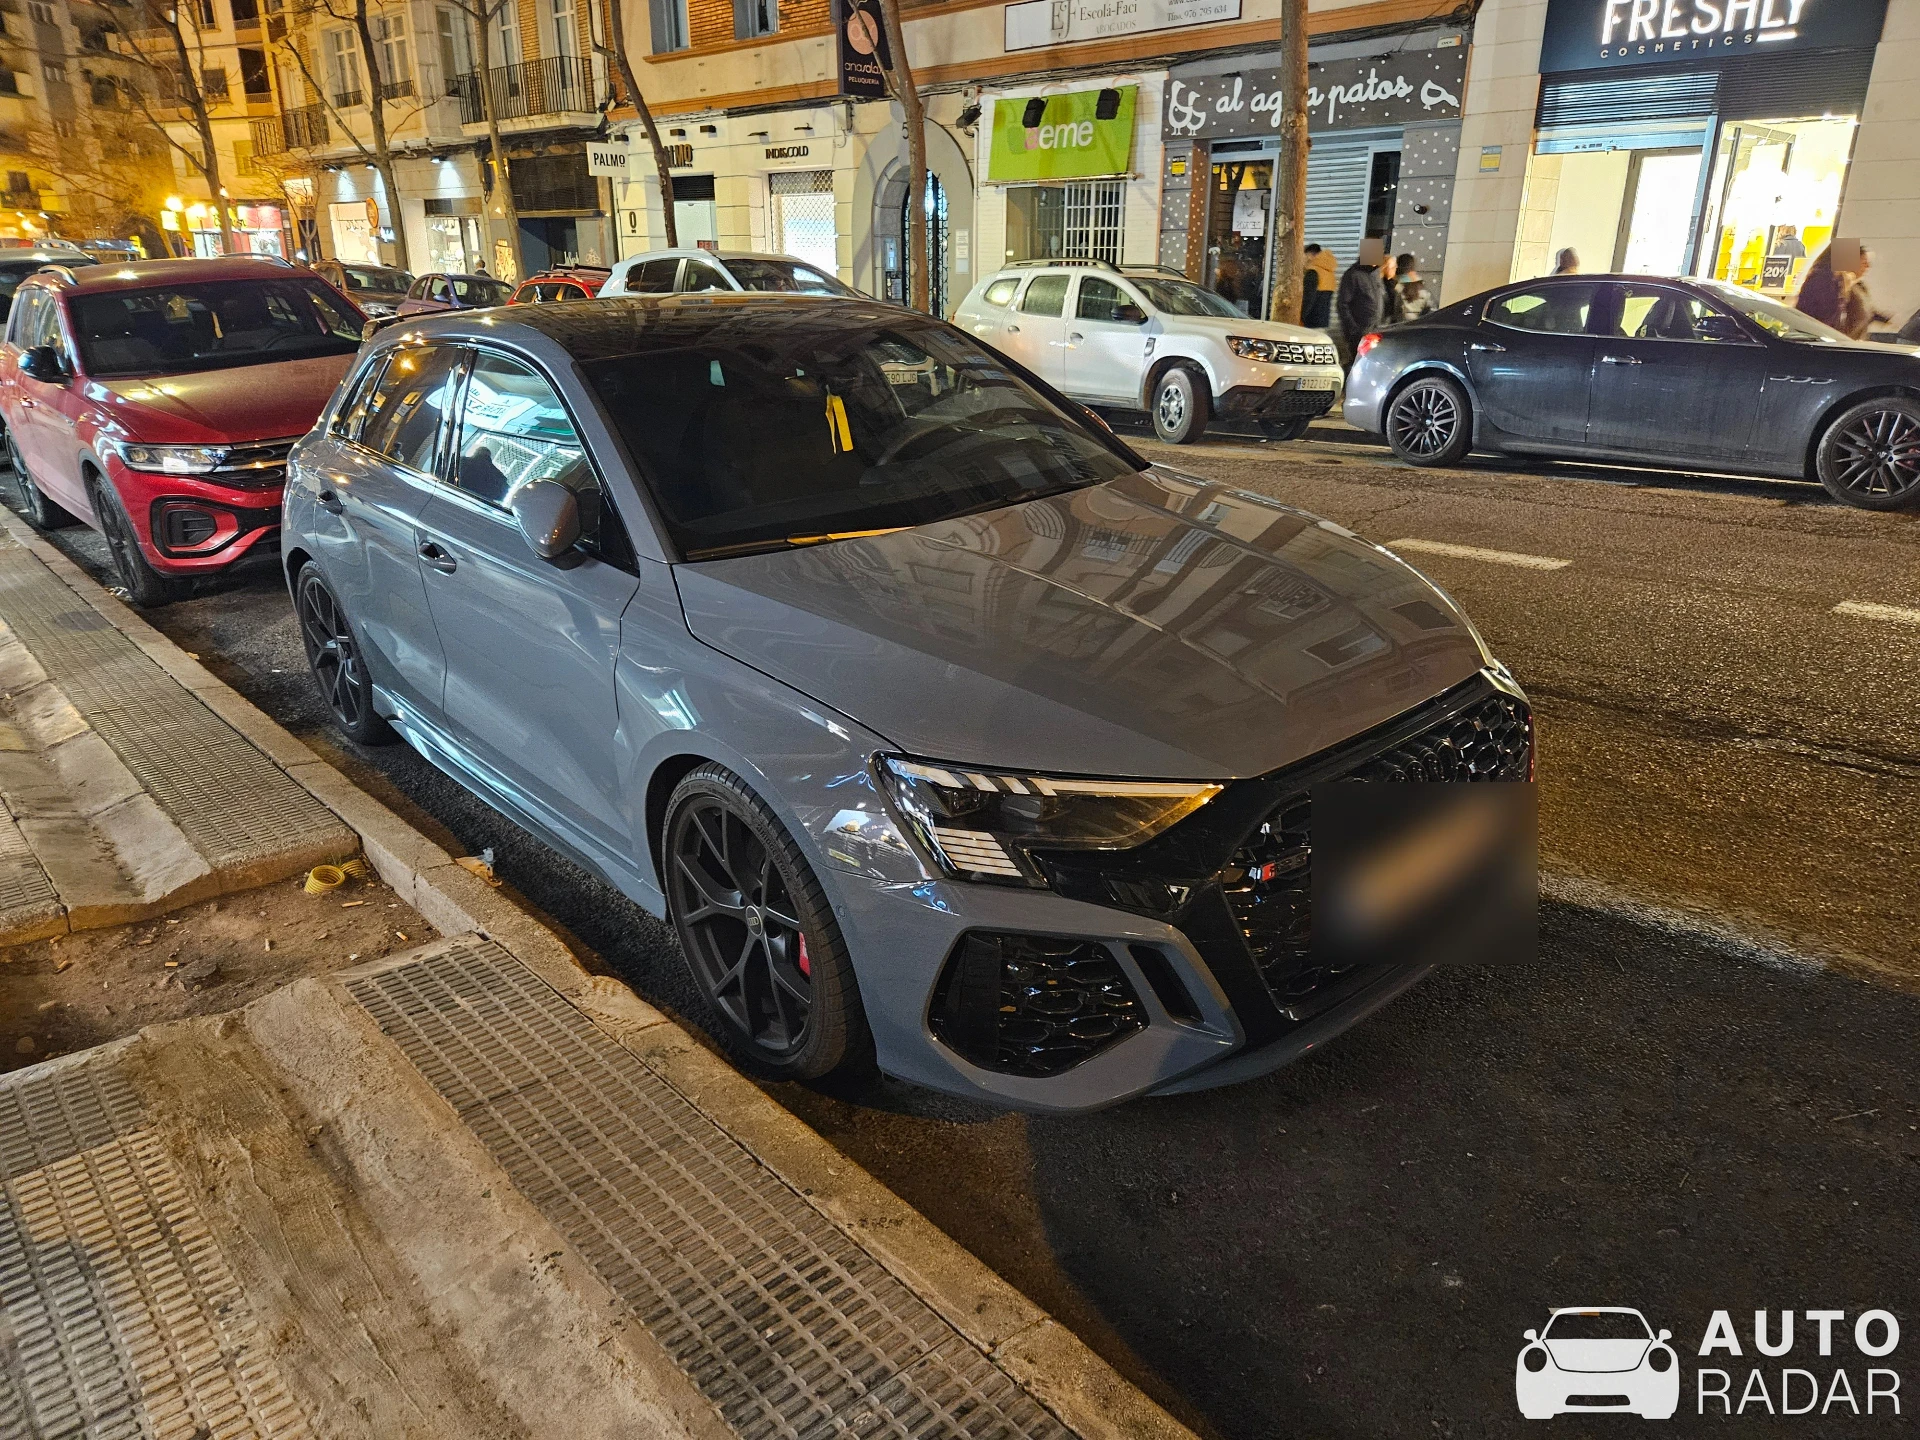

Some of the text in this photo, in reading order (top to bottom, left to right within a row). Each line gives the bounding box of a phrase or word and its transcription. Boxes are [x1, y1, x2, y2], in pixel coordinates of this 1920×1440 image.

[1080, 0, 1137, 21] Escolá-Faci
[1096, 20, 1137, 34] ABOGADOS
[1601, 0, 1803, 45] FRESHLY
[1600, 34, 1753, 59] COSMETICS
[1215, 67, 1414, 128] al aga patos
[593, 152, 626, 168] PALMO
[1302, 379, 1318, 389] 9122
